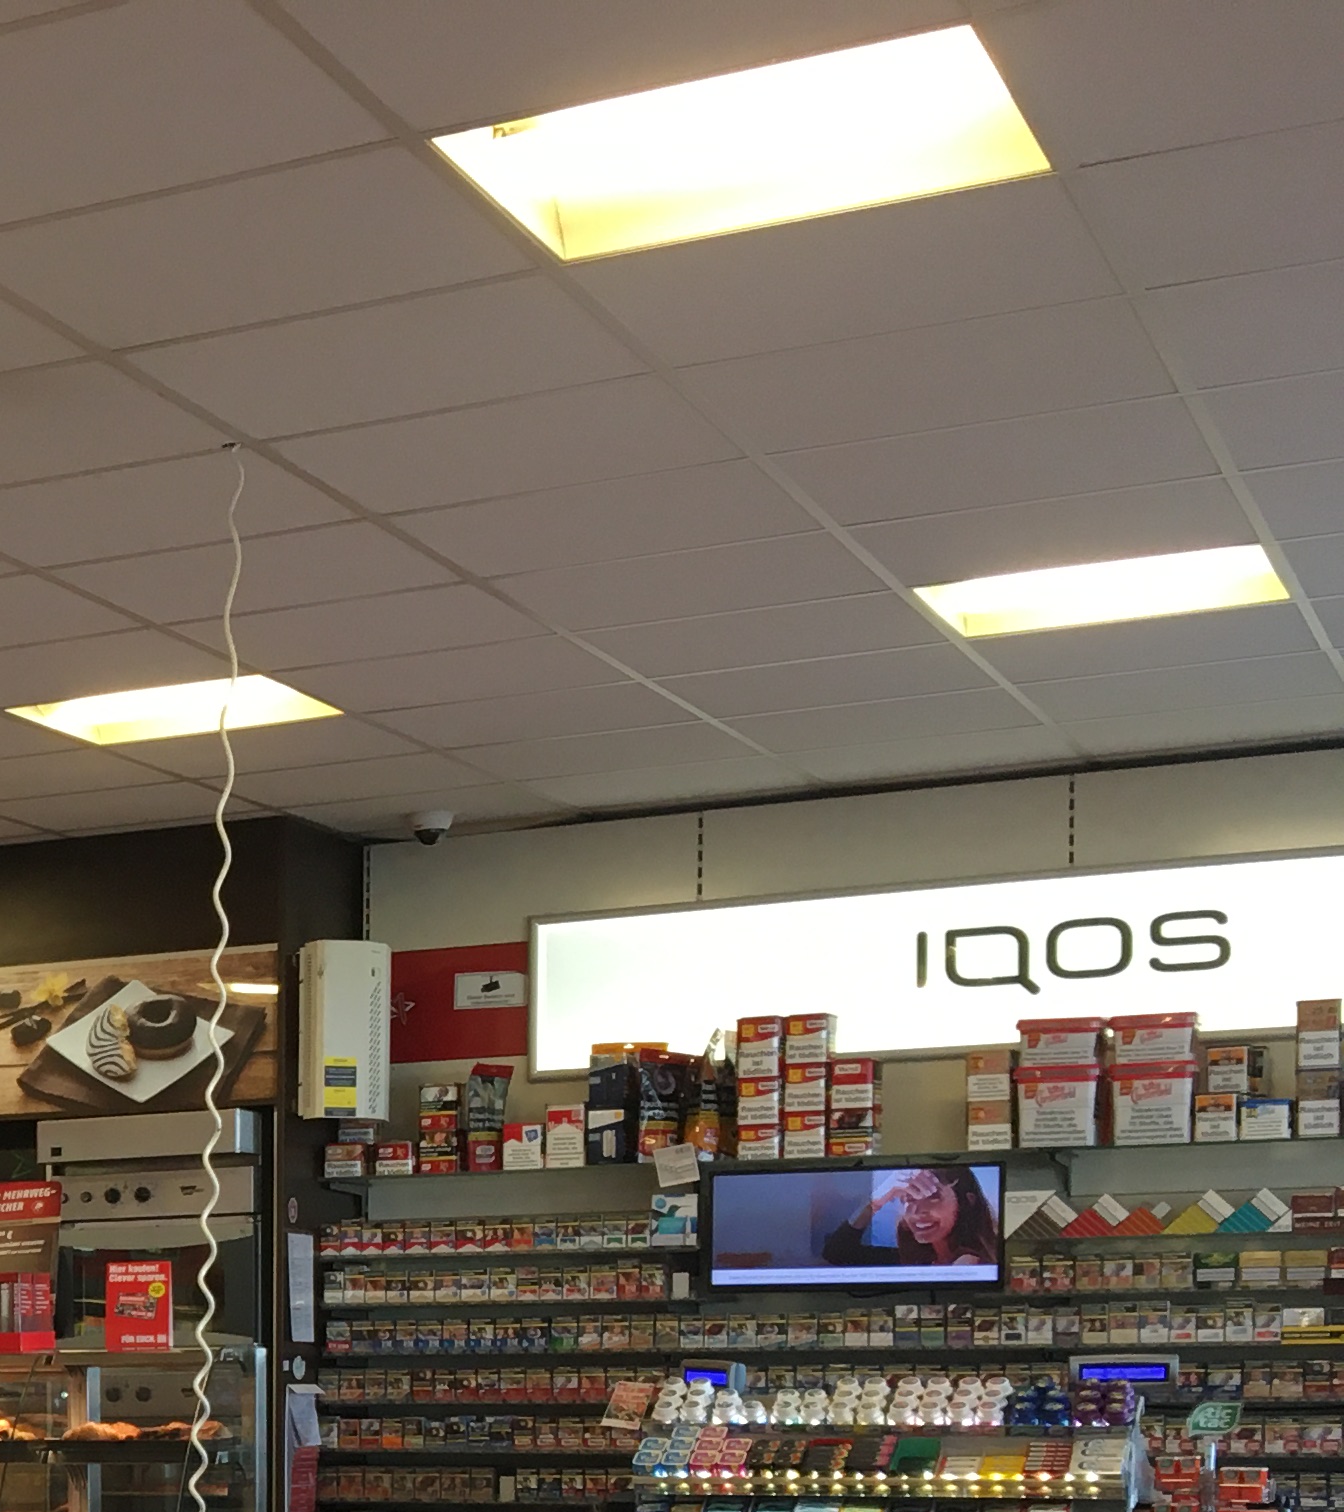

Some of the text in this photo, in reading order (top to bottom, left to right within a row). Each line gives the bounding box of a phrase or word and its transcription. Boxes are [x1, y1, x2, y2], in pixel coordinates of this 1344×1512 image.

[916, 909, 1232, 995] IQOS
[1200, 1407, 1233, 1419] tic
[1199, 1417, 1231, 1429] tac
